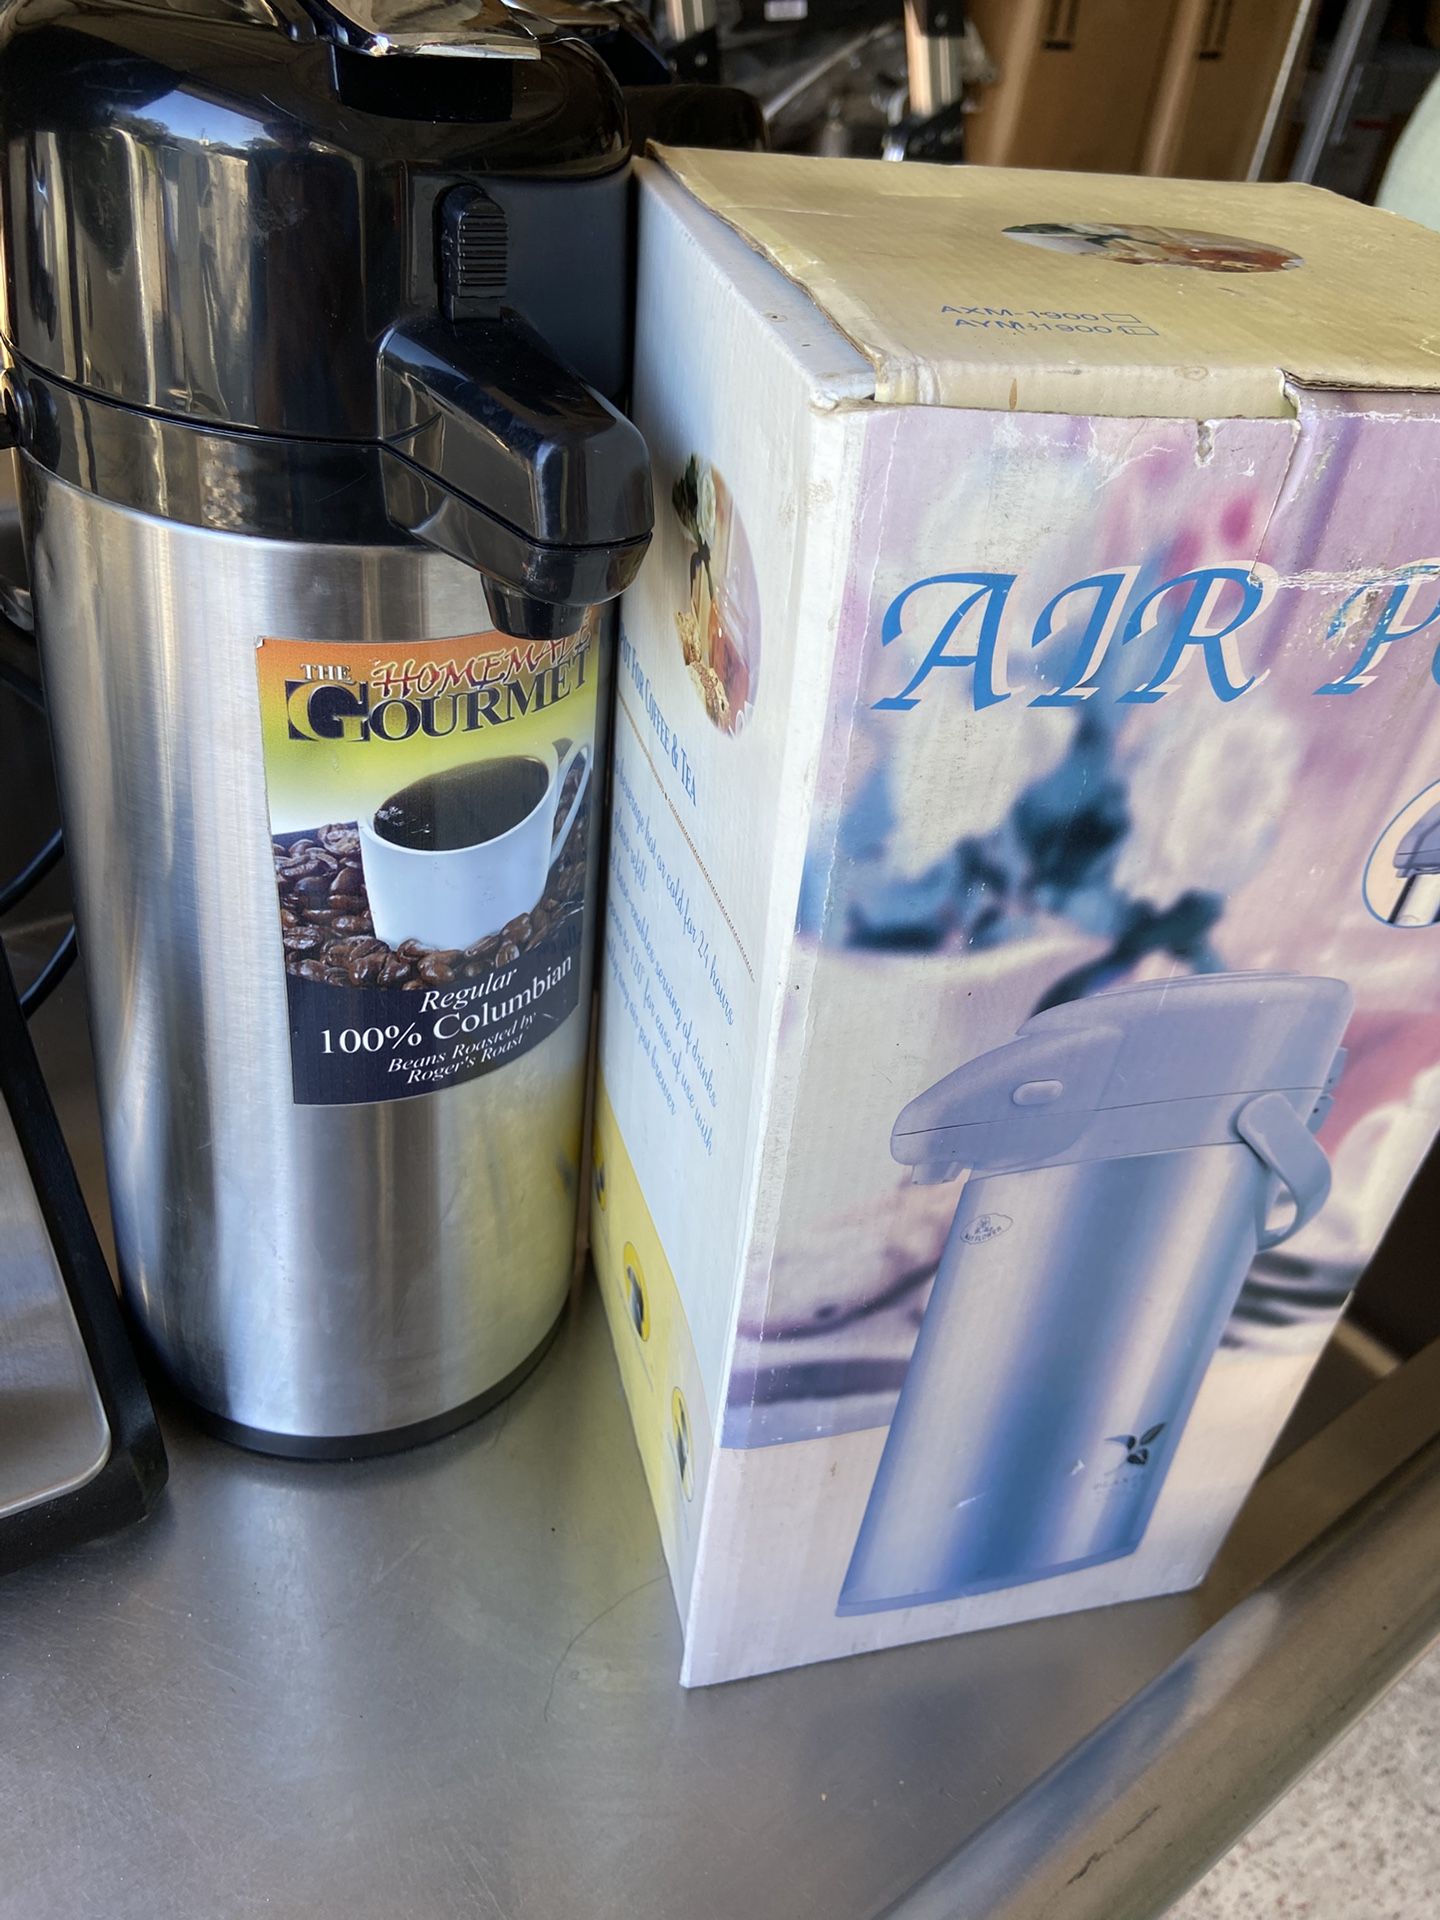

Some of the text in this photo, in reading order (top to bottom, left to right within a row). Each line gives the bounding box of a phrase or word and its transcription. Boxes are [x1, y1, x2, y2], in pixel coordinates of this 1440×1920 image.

[941, 305, 1099, 321] AXM-1900
[301, 663, 351, 682] THE
[870, 558, 1440, 711] AIR P
[285, 642, 591, 742] GOURMET
[645, 678, 669, 755] COFFEE
[671, 733, 679, 771] &
[681, 747, 696, 807] TEA
[418, 968, 518, 1013] Regular
[666, 877, 684, 915] cold
[683, 897, 697, 944] for
[697, 930, 709, 969] 24
[709, 955, 734, 1026] hours
[320, 1022, 422, 1055] 100%
[433, 956, 572, 1040] Columbian
[388, 1012, 537, 1073] Beans Roasted by
[655, 959, 682, 1030] serving
[682, 1018, 694, 1051] of
[692, 1037, 717, 1108] drinks
[407, 1034, 524, 1084] Roger's Roast
[643, 977, 656, 1018] for
[655, 1015, 672, 1056] ease
[672, 1050, 683, 1082] of
[681, 1075, 695, 1110] use
[694, 1105, 712, 1157] with
